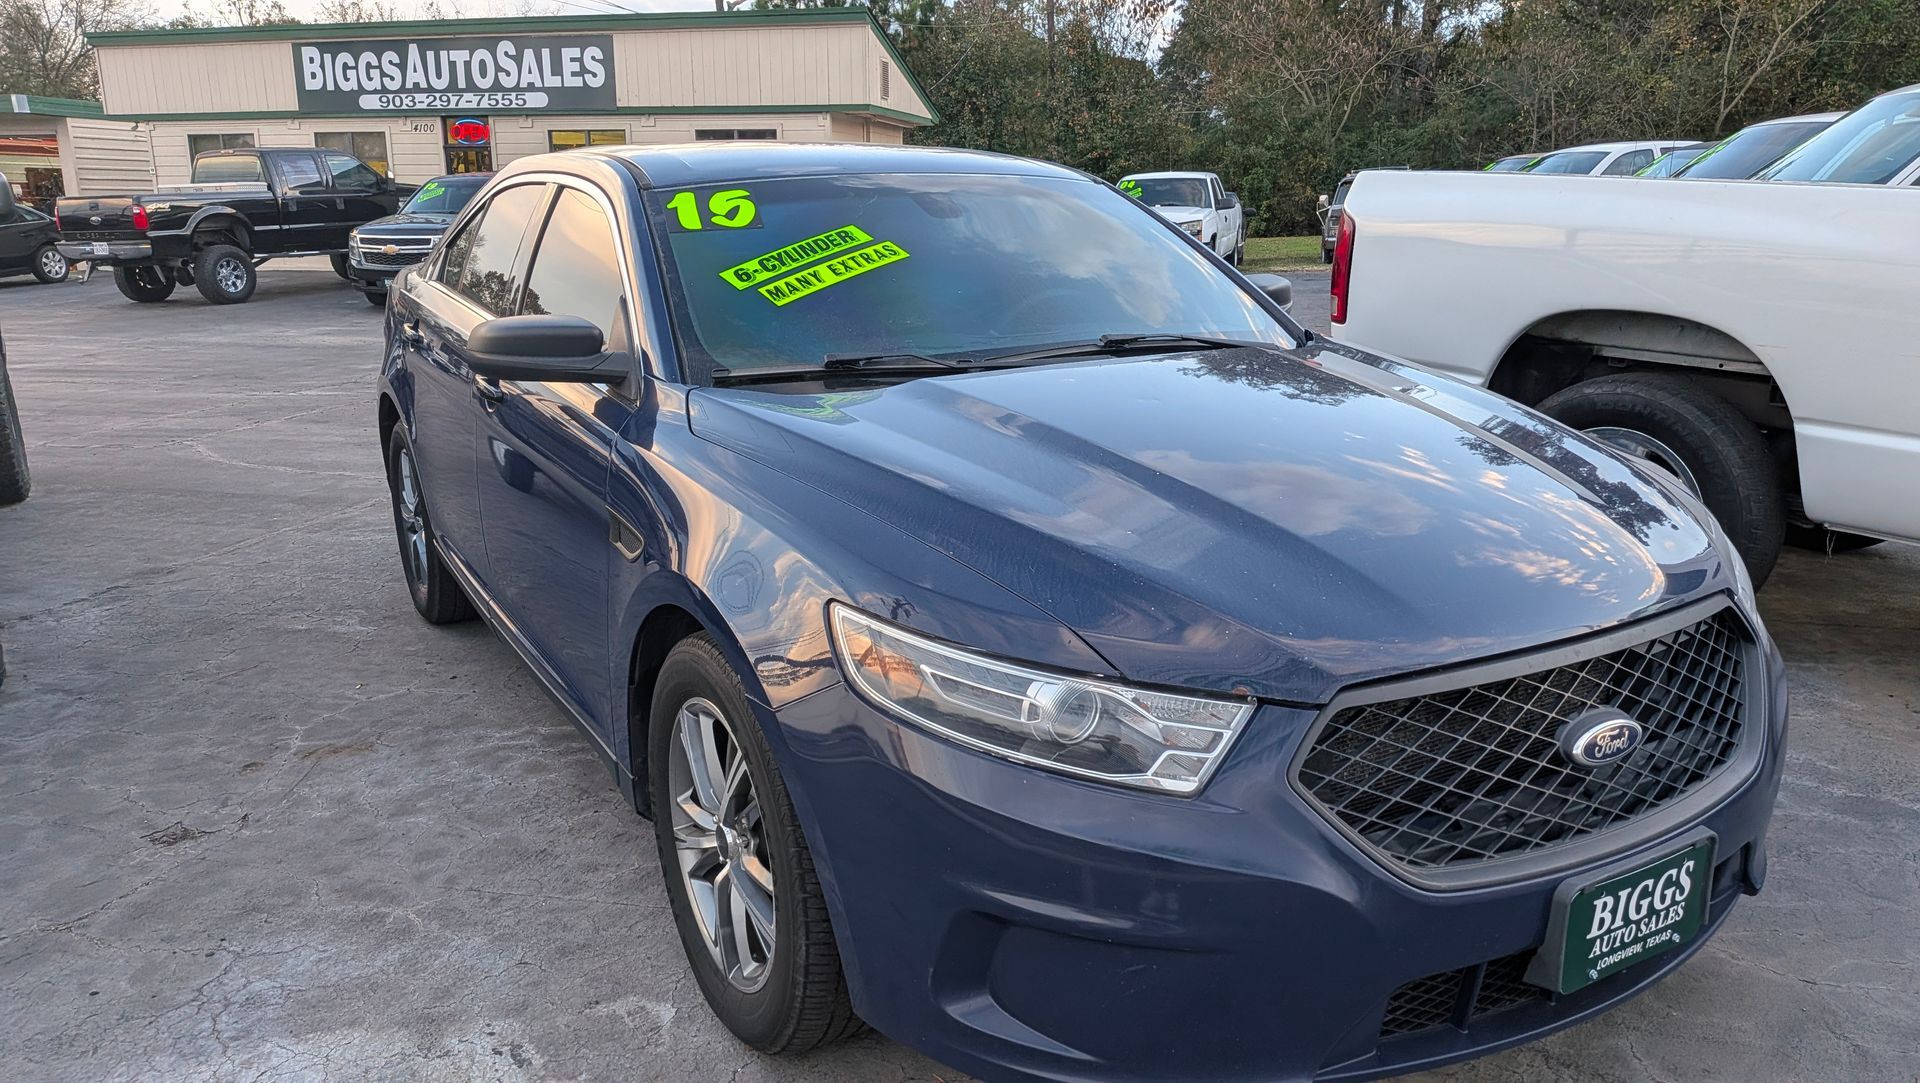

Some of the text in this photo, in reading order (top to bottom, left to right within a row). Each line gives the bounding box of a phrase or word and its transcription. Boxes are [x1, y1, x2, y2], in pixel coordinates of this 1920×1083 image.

[379, 93, 527, 109] 903-297-7555
[413, 123, 435, 133] 4100
[450, 123, 490, 141] OPEN
[666, 189, 757, 230] 15
[733, 229, 857, 283] 6-CYLINDER
[765, 244, 901, 302] MANY EXTRAS
[1594, 728, 1630, 758] Ford
[1586, 860, 1695, 939] BIGGS
[1588, 902, 1685, 958] AUTO SALES
[1596, 930, 1672, 970] LONGVIEW, TEXAS
